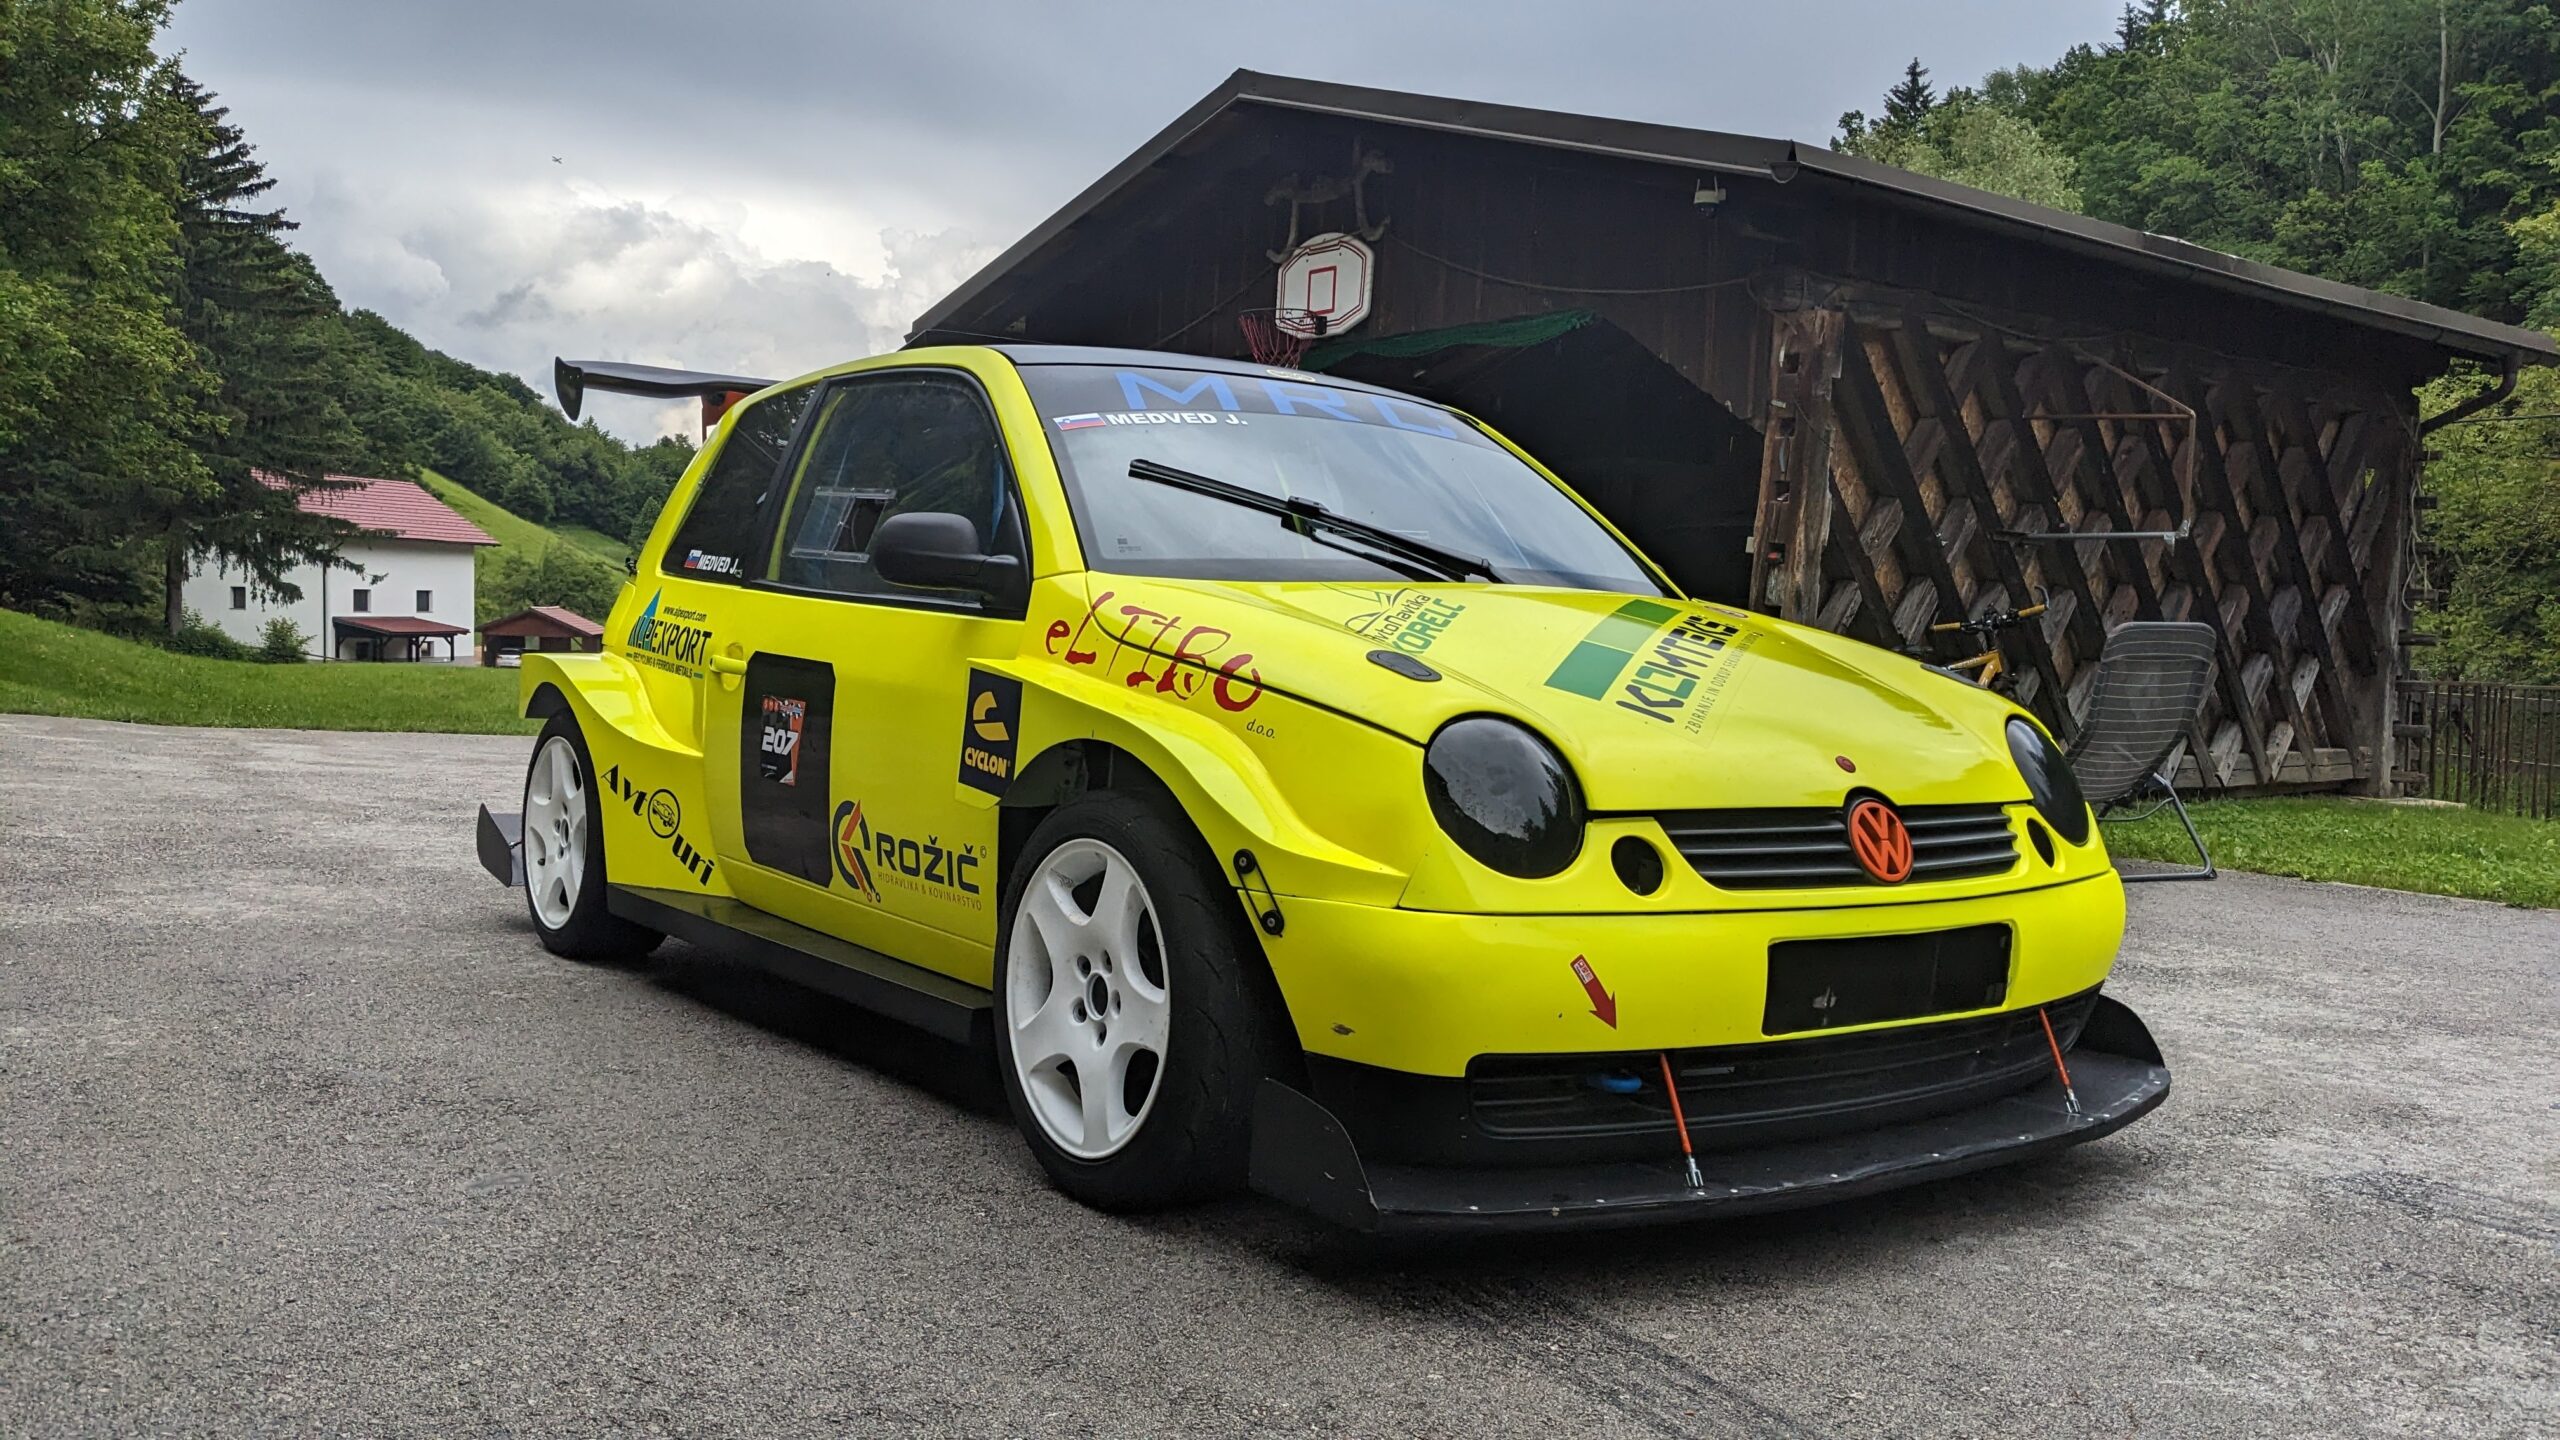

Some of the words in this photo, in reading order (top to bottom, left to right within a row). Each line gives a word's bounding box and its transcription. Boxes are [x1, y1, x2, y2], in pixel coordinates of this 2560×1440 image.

[1106, 412, 1217, 426] MEDVED
[1225, 412, 1248, 425] J.
[697, 555, 731, 573] MEDVED
[1391, 598, 1466, 654] KORELC
[1246, 719, 1275, 739] d.o.o.
[1684, 695, 1717, 735] ZBIRANJE
[761, 726, 799, 756] 207
[964, 747, 1007, 778] CYCLON
[876, 832, 979, 895] ROŽIČ
[878, 871, 919, 891] HIDRAVLIKA
[929, 887, 982, 911] KOVINARSTVO
